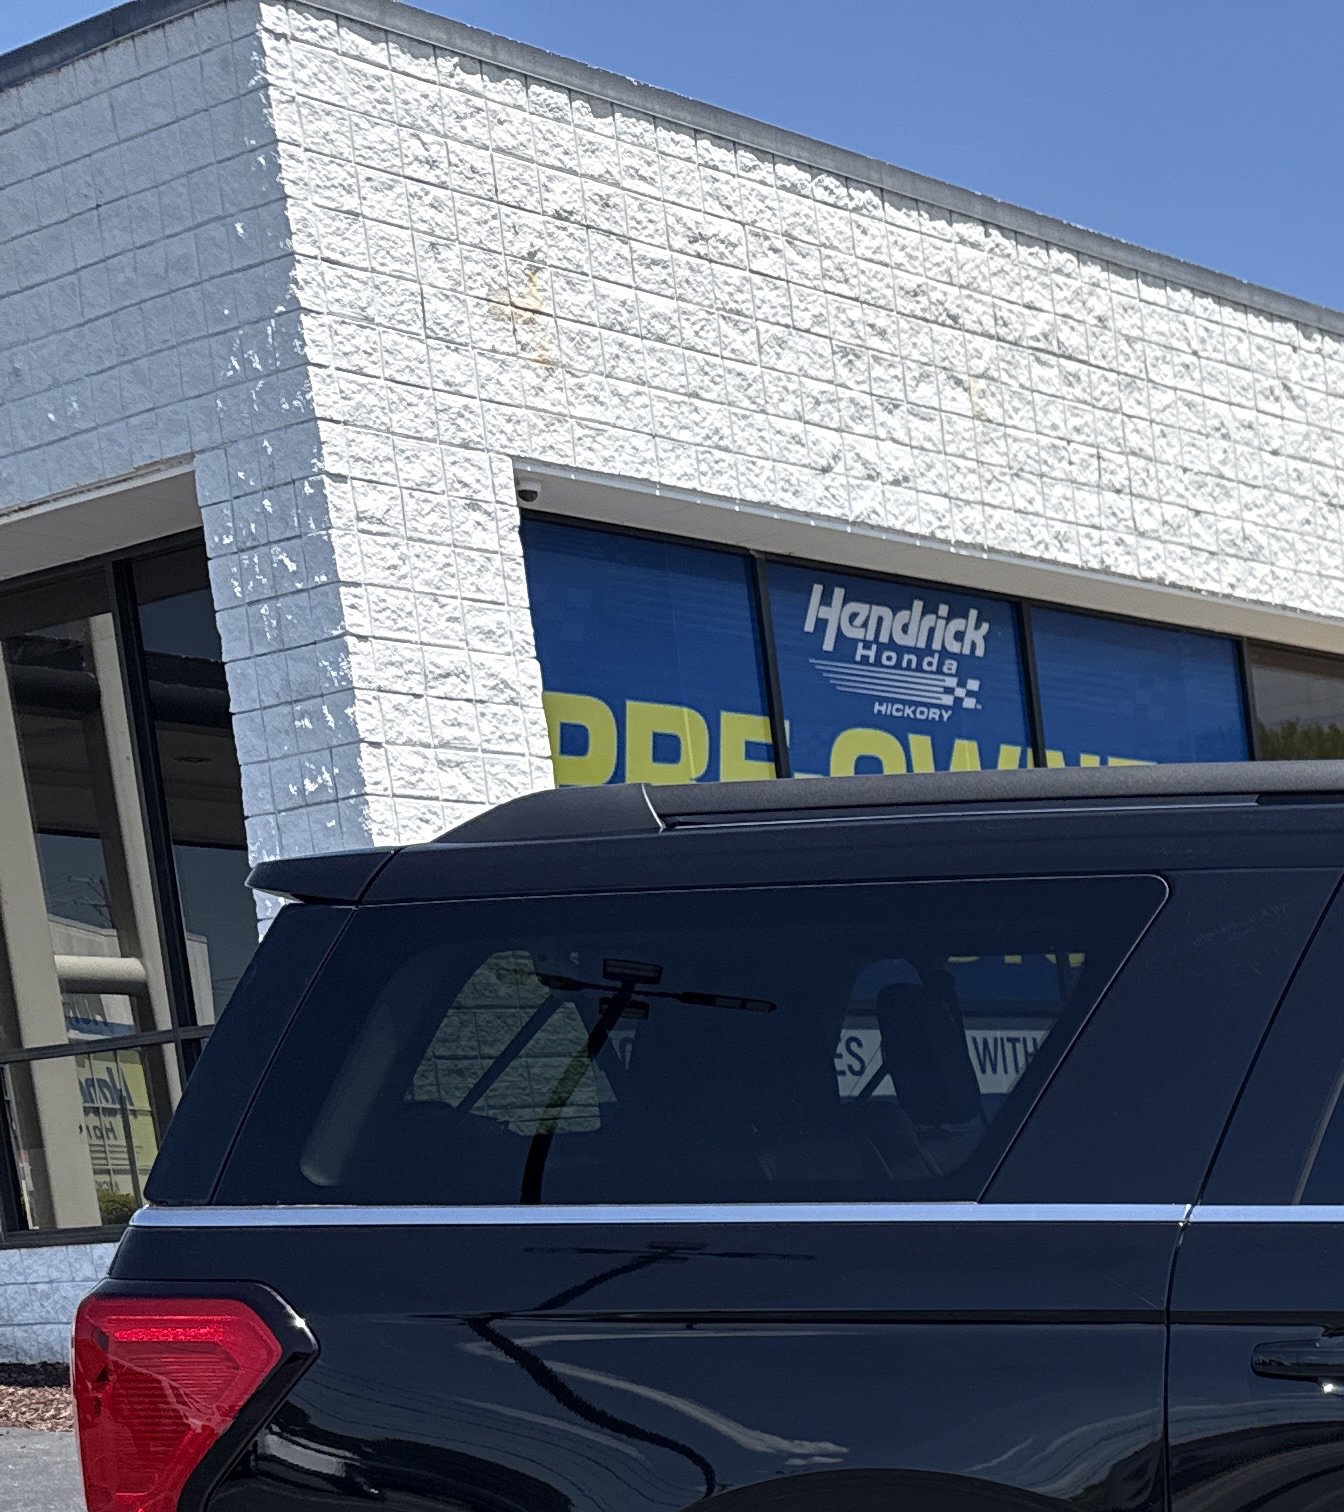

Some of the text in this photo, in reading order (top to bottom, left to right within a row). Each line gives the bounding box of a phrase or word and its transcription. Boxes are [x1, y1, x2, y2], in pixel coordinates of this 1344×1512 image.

[804, 584, 990, 658] Hendrick
[855, 641, 958, 675] Honda
[873, 701, 953, 723] HICKORY
